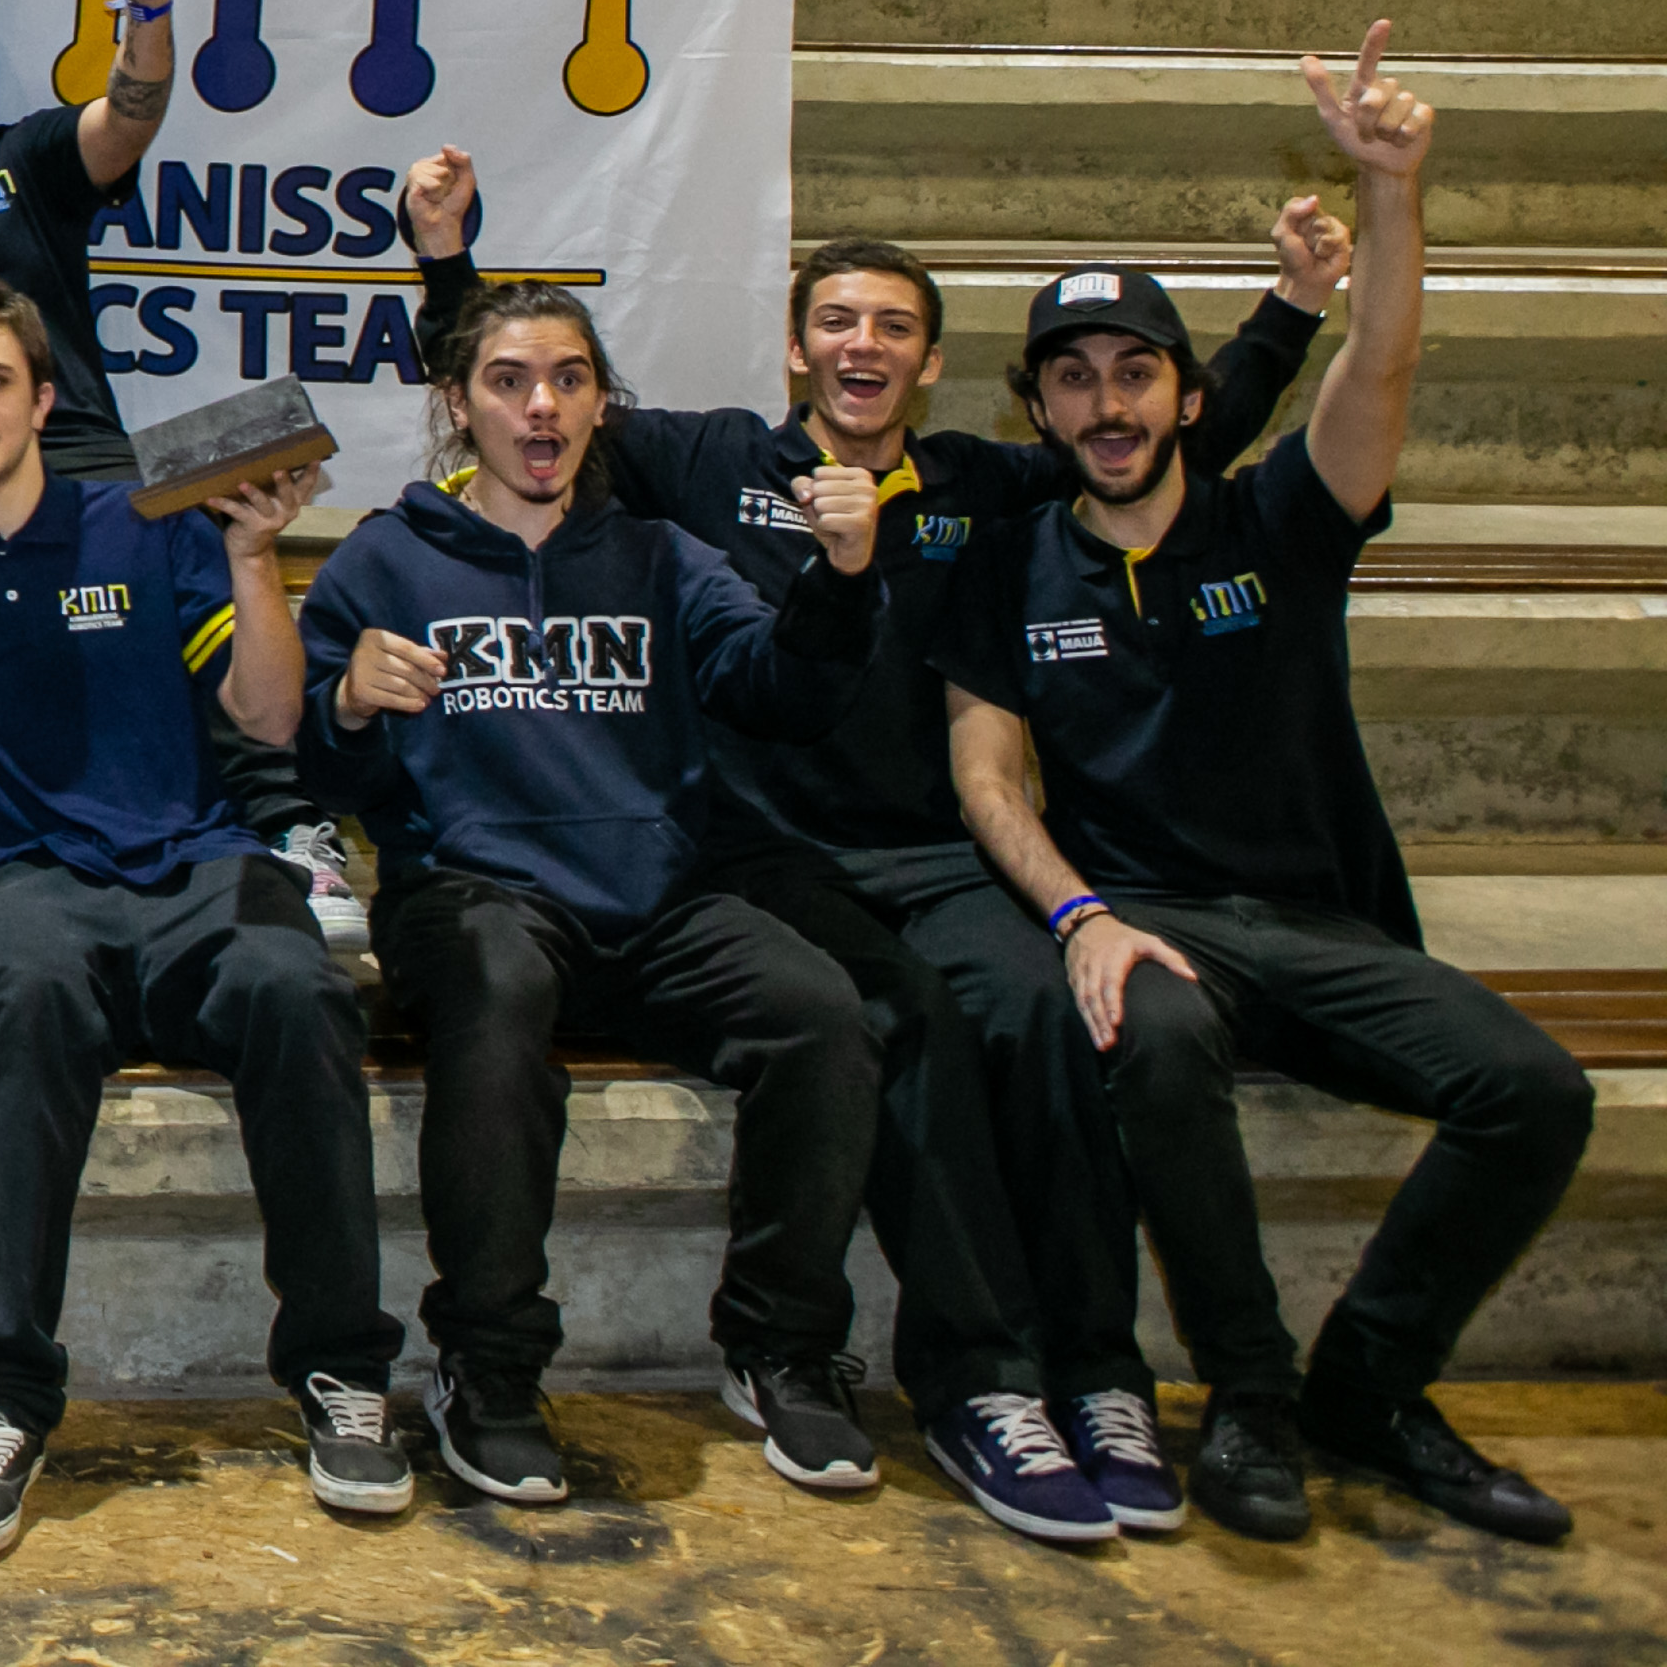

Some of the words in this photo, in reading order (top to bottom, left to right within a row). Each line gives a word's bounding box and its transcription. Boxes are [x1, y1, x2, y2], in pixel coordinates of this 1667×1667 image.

[220, 288, 431, 386] TEA
[770, 508, 807, 523] MAU
[428, 615, 652, 688] KMN
[1059, 633, 1105, 650] MAUÁ
[444, 687, 568, 715] ROBOTICS
[572, 688, 645, 713] TEAM
